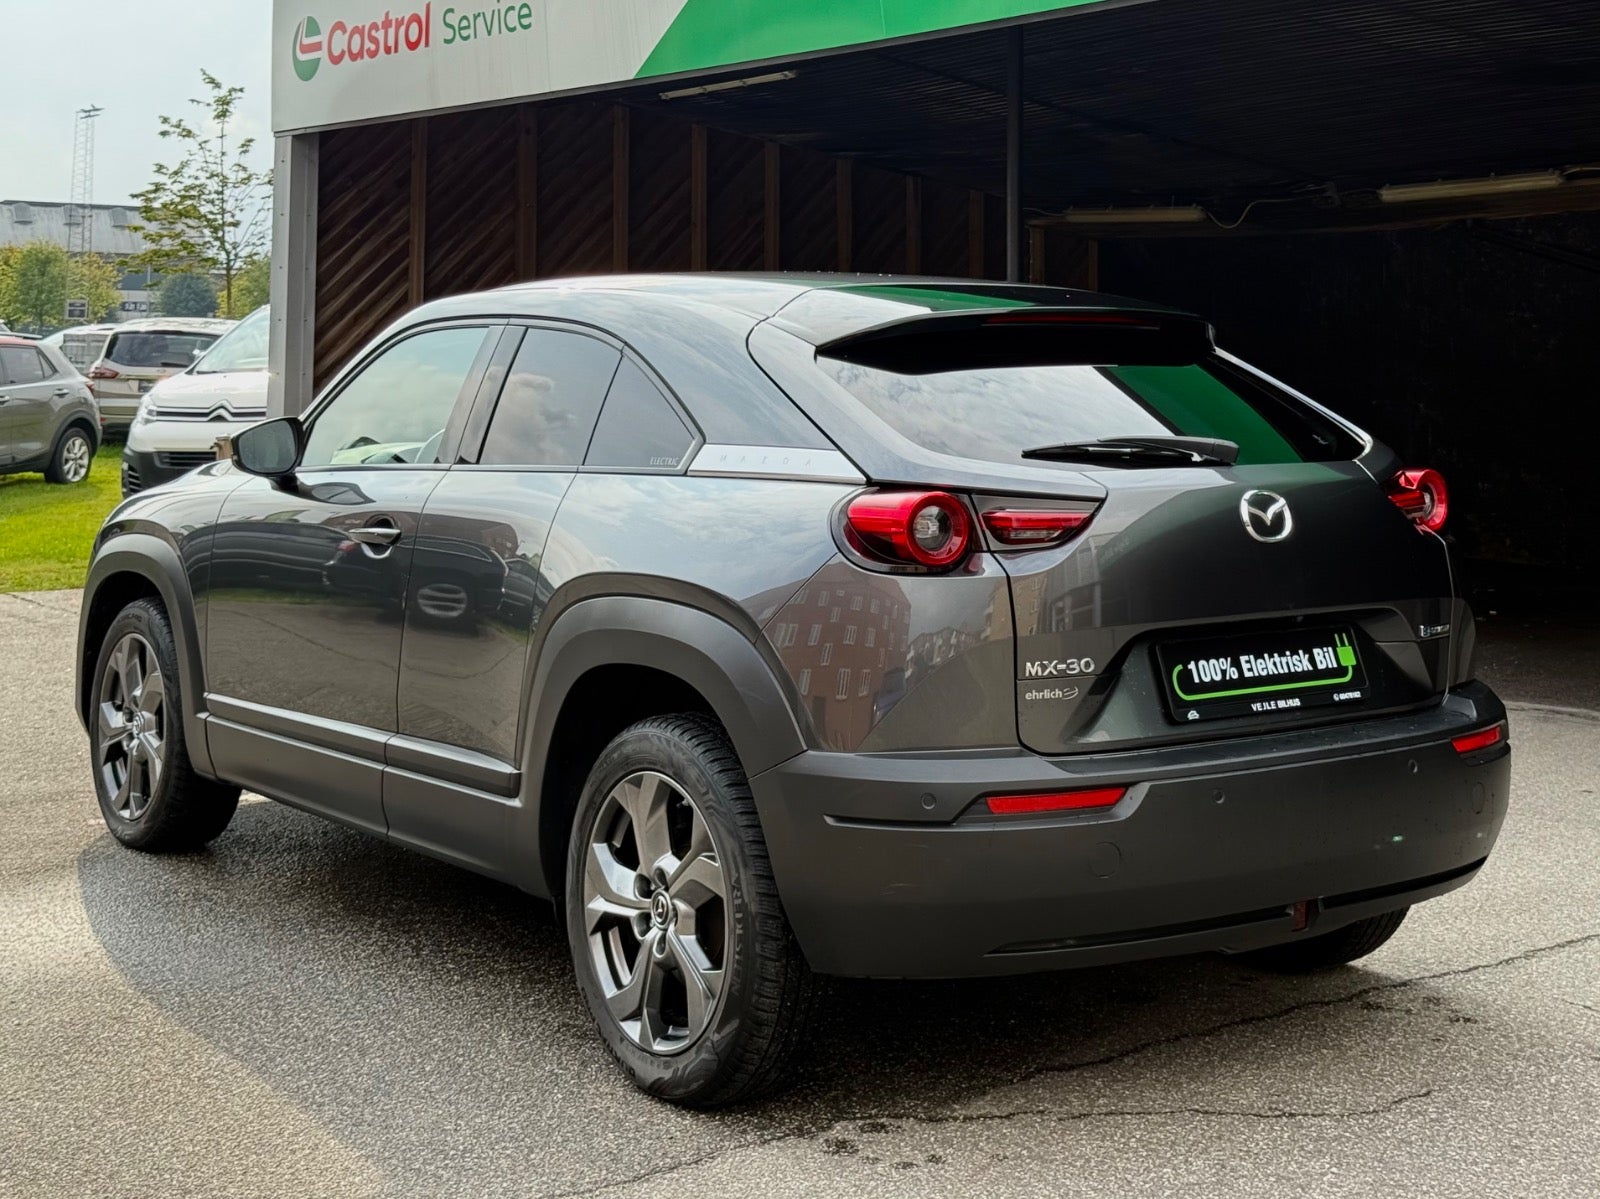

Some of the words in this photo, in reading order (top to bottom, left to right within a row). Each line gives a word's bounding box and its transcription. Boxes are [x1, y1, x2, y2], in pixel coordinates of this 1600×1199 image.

[327, 1, 432, 66] Castrol
[442, 0, 533, 45] Service
[650, 456, 680, 466] ELECTRIC
[1025, 657, 1095, 677] MX-30
[1187, 657, 1239, 684] 100%
[1239, 650, 1311, 678] Elektrisk
[1312, 646, 1338, 670] Bil
[1025, 688, 1063, 700] ehrlich
[1251, 700, 1277, 712] VEJLE
[1277, 698, 1301, 708] BILHUS
